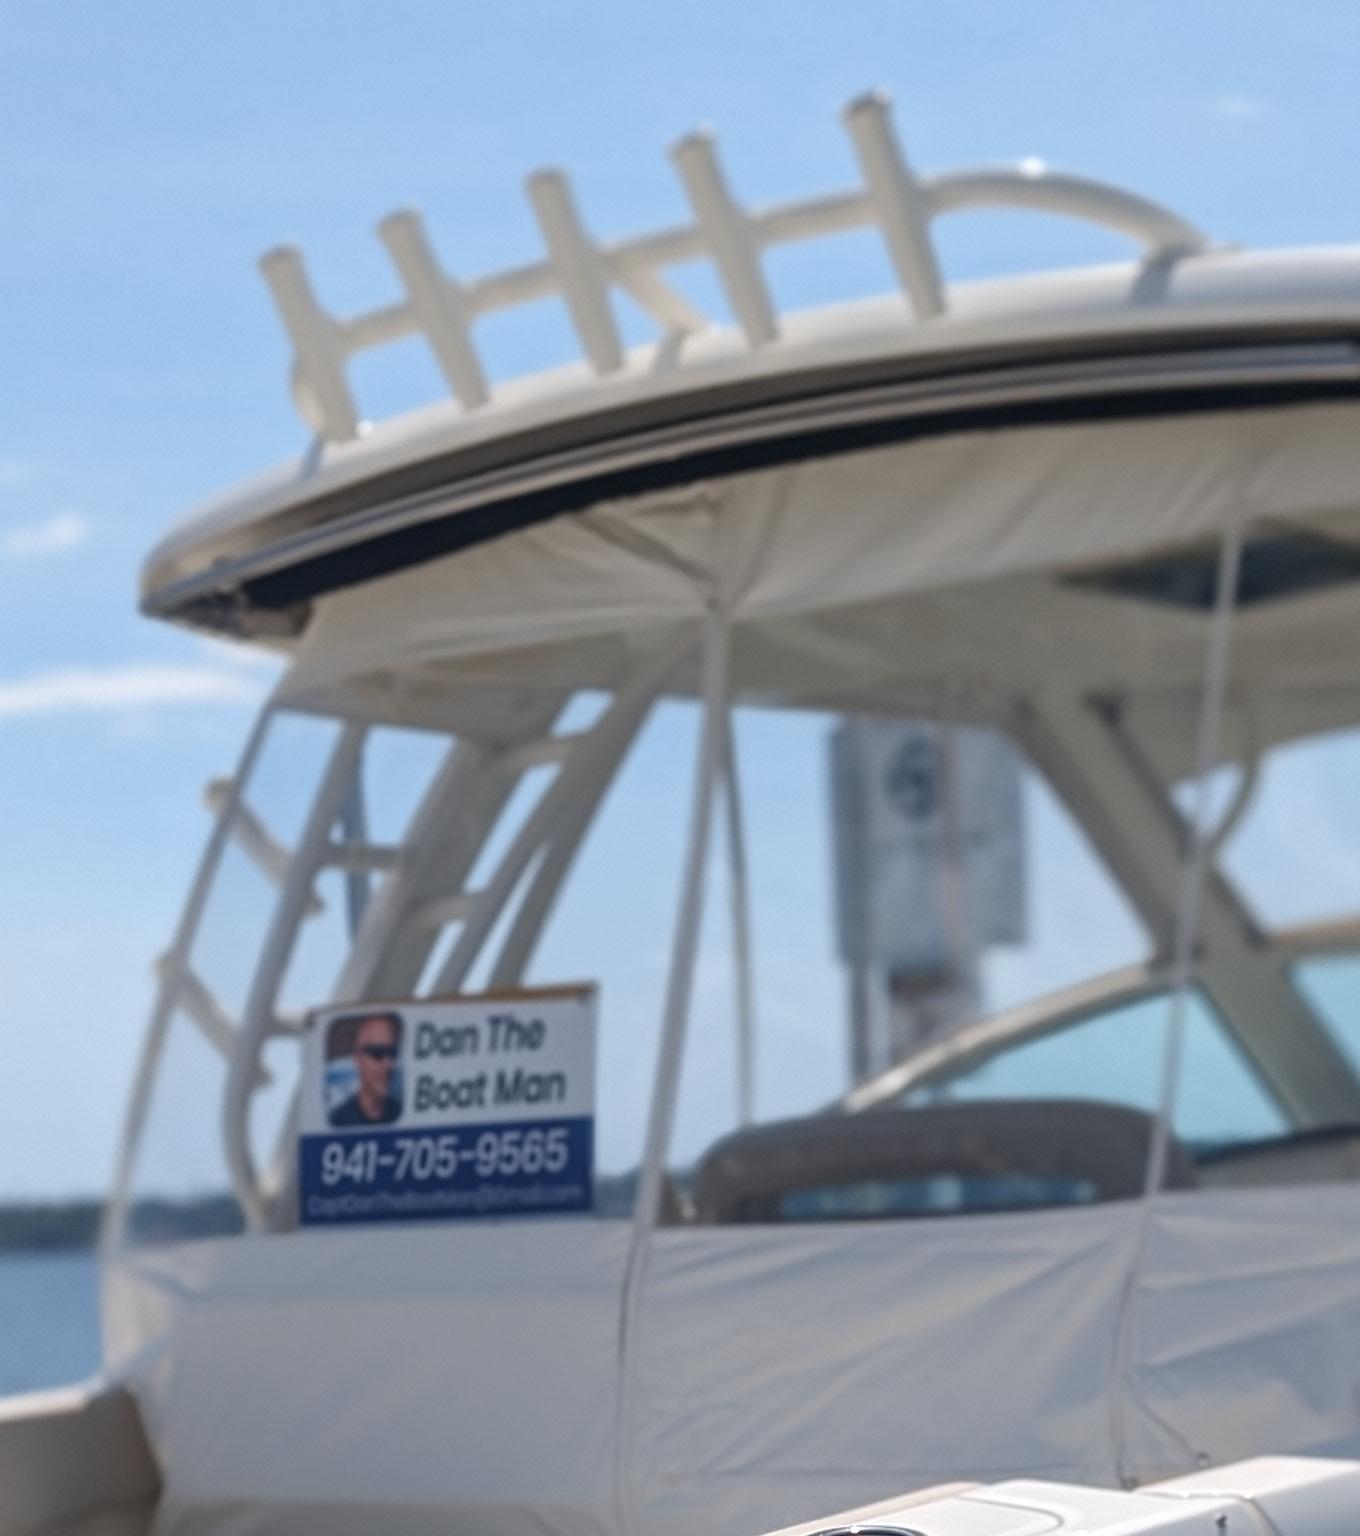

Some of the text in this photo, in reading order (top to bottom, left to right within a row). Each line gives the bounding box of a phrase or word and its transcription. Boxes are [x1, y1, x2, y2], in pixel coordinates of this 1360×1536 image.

[414, 1013, 546, 1061] Dan The
[414, 1067, 567, 1113] Boat Man
[321, 1127, 569, 1186] 941-705-9565
